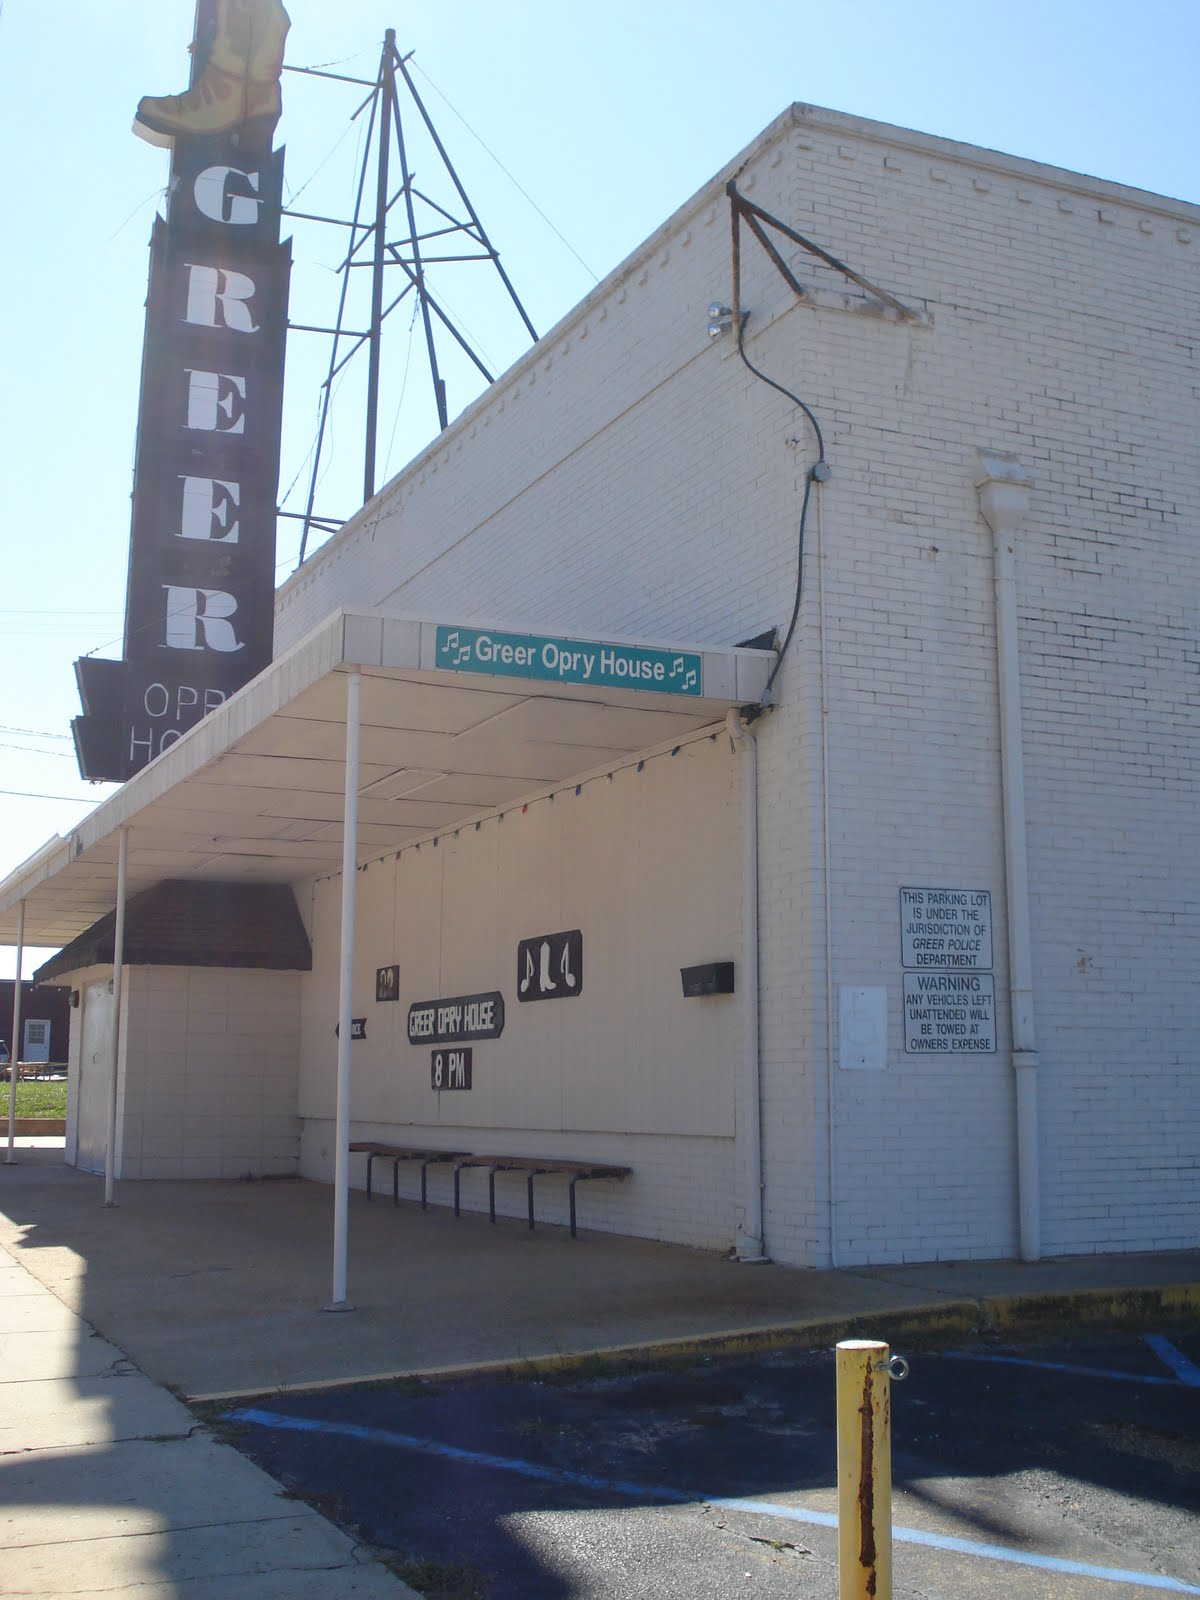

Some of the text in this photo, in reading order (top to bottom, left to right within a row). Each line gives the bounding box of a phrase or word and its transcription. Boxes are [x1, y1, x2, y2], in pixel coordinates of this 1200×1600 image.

[157, 166, 264, 652] GREER
[475, 635, 665, 681] Greer Opry House
[144, 683, 234, 719] OPR
[903, 891, 988, 906] THIS PARKING LOT
[913, 907, 979, 921] IS UNDER THE
[906, 923, 986, 936] JURISDICTION OF
[912, 938, 981, 951] GREER POLICE
[916, 953, 977, 966] DEPARTMENT
[917, 976, 980, 991] WARNING
[906, 994, 992, 1006] ANY VEHICLES LEFT
[409, 1001, 495, 1037] GREER OPRY HOUSE
[909, 1009, 989, 1020] UNATTENDED WILL
[921, 1023, 980, 1035] BE TOWED AT
[911, 1038, 991, 1050] OWNERS EXPENSE
[435, 1052, 465, 1088] 8 PM
